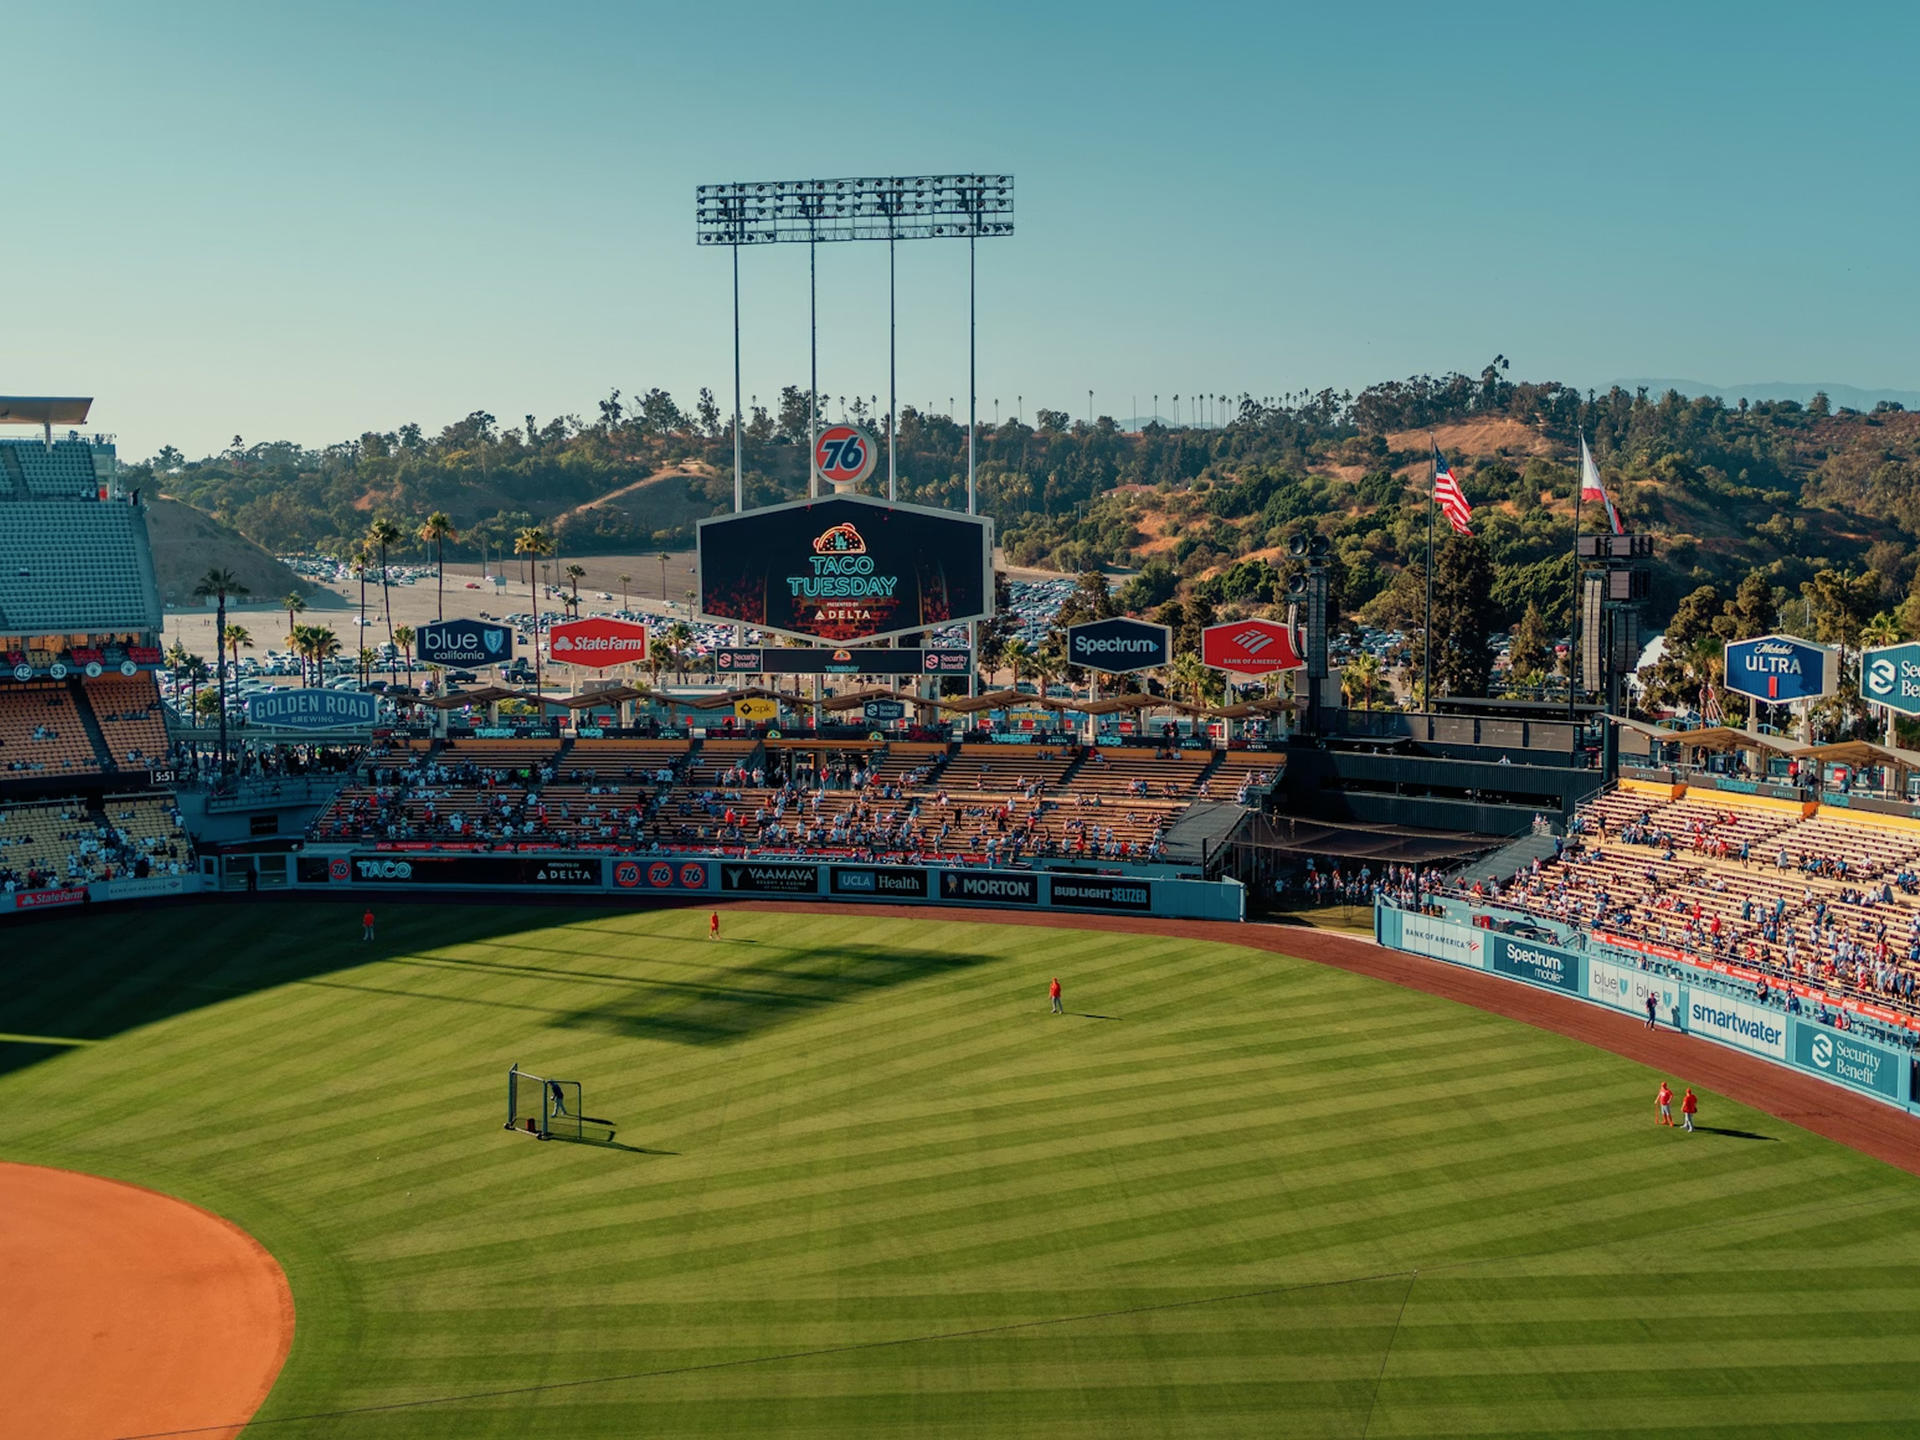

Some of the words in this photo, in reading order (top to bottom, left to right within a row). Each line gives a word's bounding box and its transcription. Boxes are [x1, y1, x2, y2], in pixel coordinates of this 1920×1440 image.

[821, 435, 864, 471] 76
[809, 556, 875, 575] TACO
[787, 577, 897, 597] TUESDAY
[828, 610, 871, 619] DELTA
[425, 629, 478, 650] blue
[1075, 636, 1153, 655] Spectrum
[434, 650, 485, 661] california
[733, 652, 759, 662] Security
[940, 654, 968, 663] Security
[940, 662, 965, 670] Benefit
[1746, 655, 1802, 674] ULTRA
[16, 669, 31, 677] 42
[52, 667, 65, 676] 53
[255, 695, 322, 719] GOLDEN
[325, 695, 370, 719] ROAD
[753, 706, 771, 714] cpk
[291, 715, 334, 724] BREWING
[475, 728, 516, 737] TUESDAY
[577, 728, 604, 738] TACO
[991, 734, 1033, 744] TUESDAY
[1096, 736, 1122, 745] TACO
[156, 771, 175, 782] 5:51
[333, 864, 347, 875] 76
[357, 861, 412, 879] TACO
[550, 871, 591, 880] DELTA
[620, 867, 637, 880] 76
[652, 867, 669, 880] 76
[684, 868, 701, 881] 76
[842, 875, 871, 886] UCLA
[878, 875, 920, 890] Health
[963, 879, 1030, 896] MORTON
[1054, 886, 1078, 897] BUD
[1079, 888, 1111, 899] LIGHT
[1112, 888, 1147, 904] SELTZER
[1405, 928, 1424, 939] BANK
[1424, 932, 1434, 941] OF
[1434, 935, 1465, 949] AMERICA
[1507, 943, 1560, 971] Spectrum
[1534, 968, 1560, 983] mobile
[1594, 970, 1617, 989] blue
[1692, 1004, 1782, 1046] smartwater
[1836, 1040, 1881, 1072] Security
[1836, 1059, 1874, 1086] Benefit
